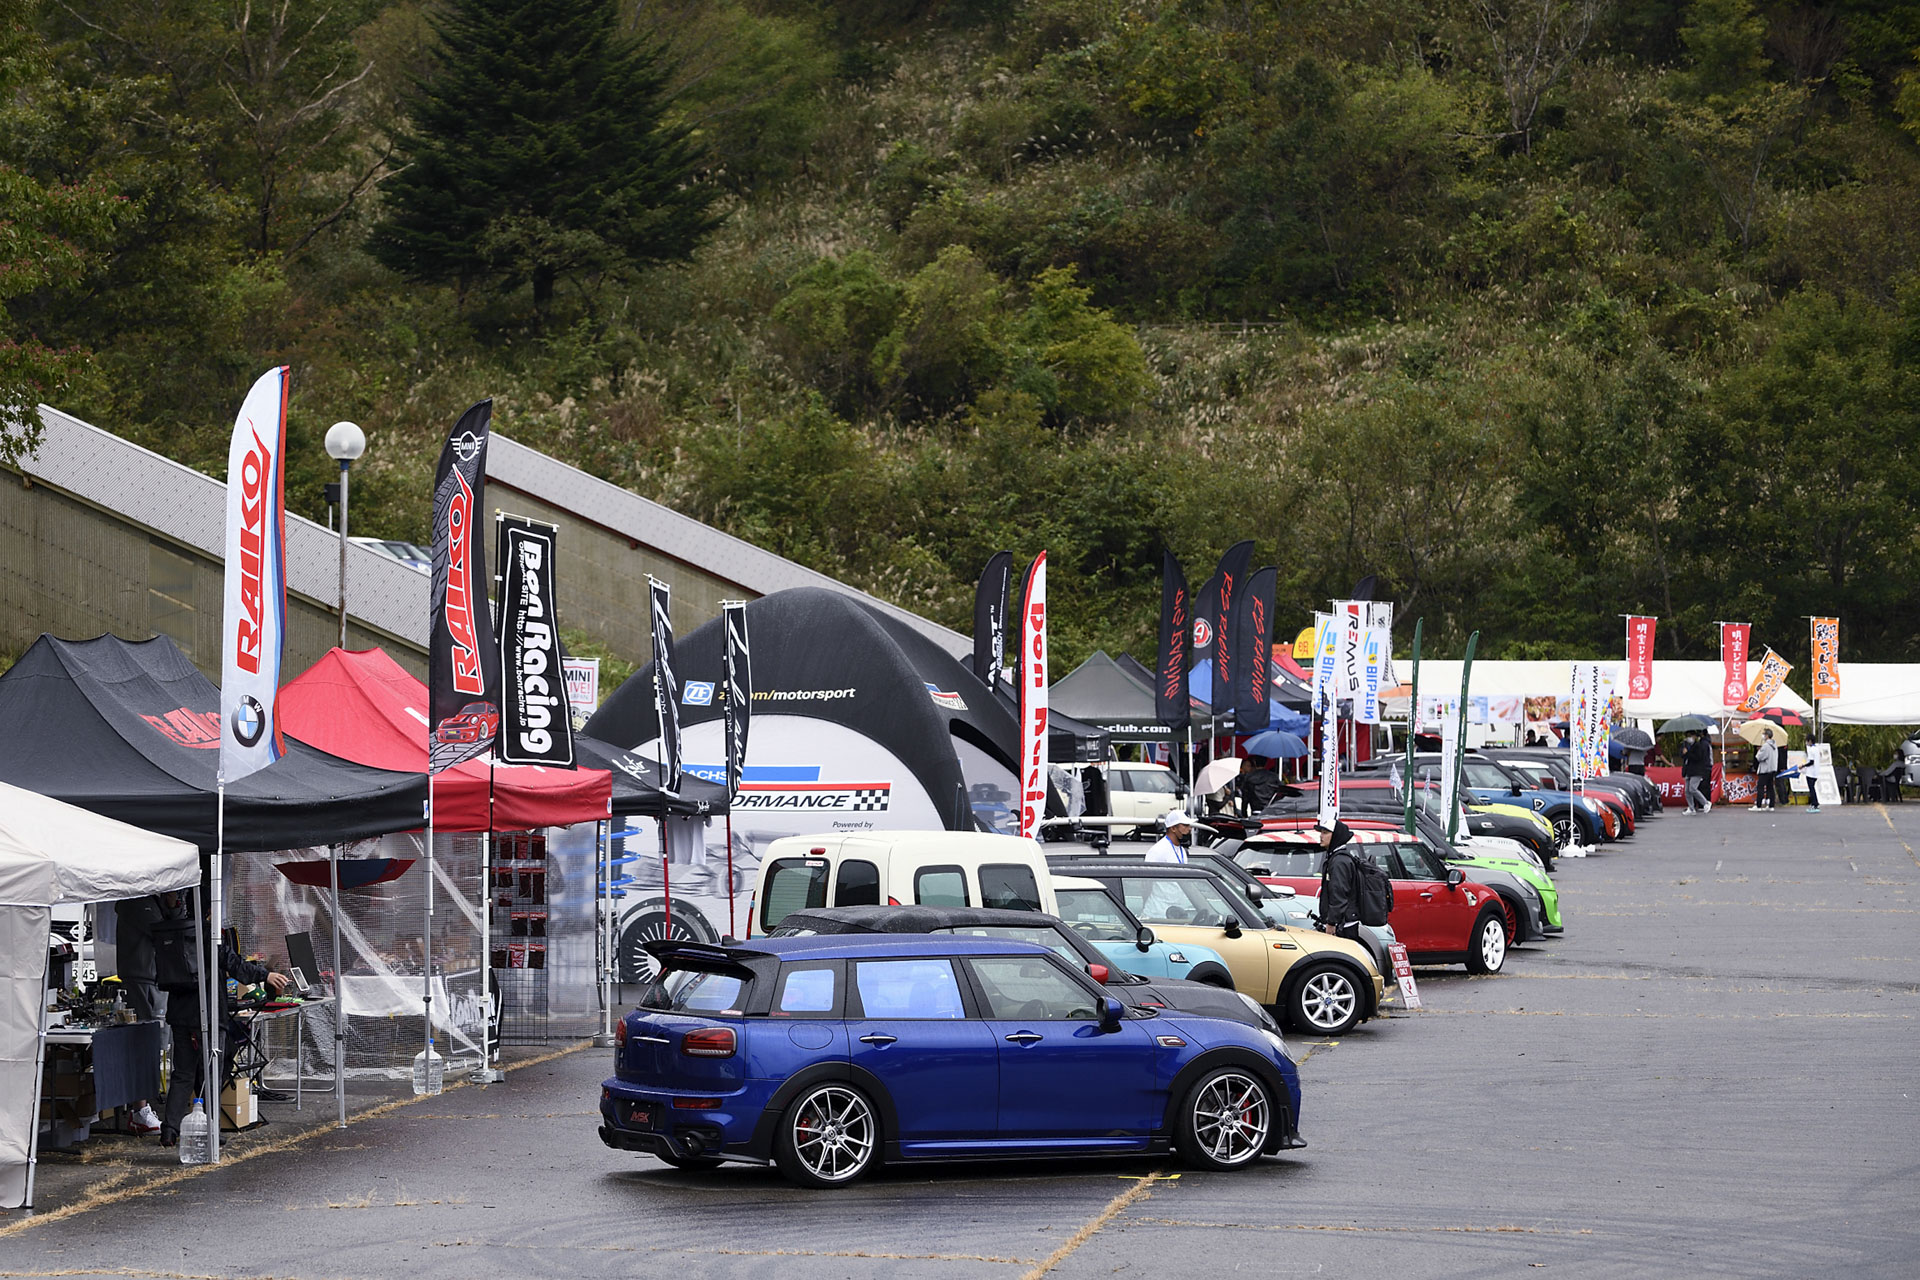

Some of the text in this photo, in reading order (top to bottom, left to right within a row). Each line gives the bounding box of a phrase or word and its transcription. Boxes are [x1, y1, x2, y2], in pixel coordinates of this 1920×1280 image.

[237, 448, 268, 675] RAIKO
[446, 492, 484, 696] RAIKO
[520, 585, 528, 605] SITE
[520, 540, 559, 754] Bon Racing
[1218, 613, 1231, 683] RACING
[1250, 635, 1266, 705] RACING
[1346, 614, 1360, 692] REMUS
[1636, 623, 1648, 674] 明宝ジビエ
[1731, 630, 1742, 680] 明宝ジビエ
[565, 670, 590, 682] MINI
[570, 682, 590, 694] IVE!
[689, 687, 709, 699] ZF
[1098, 723, 1172, 734] -club.com
[731, 794, 851, 808] ORMANCE
[832, 821, 874, 830] Powered by
